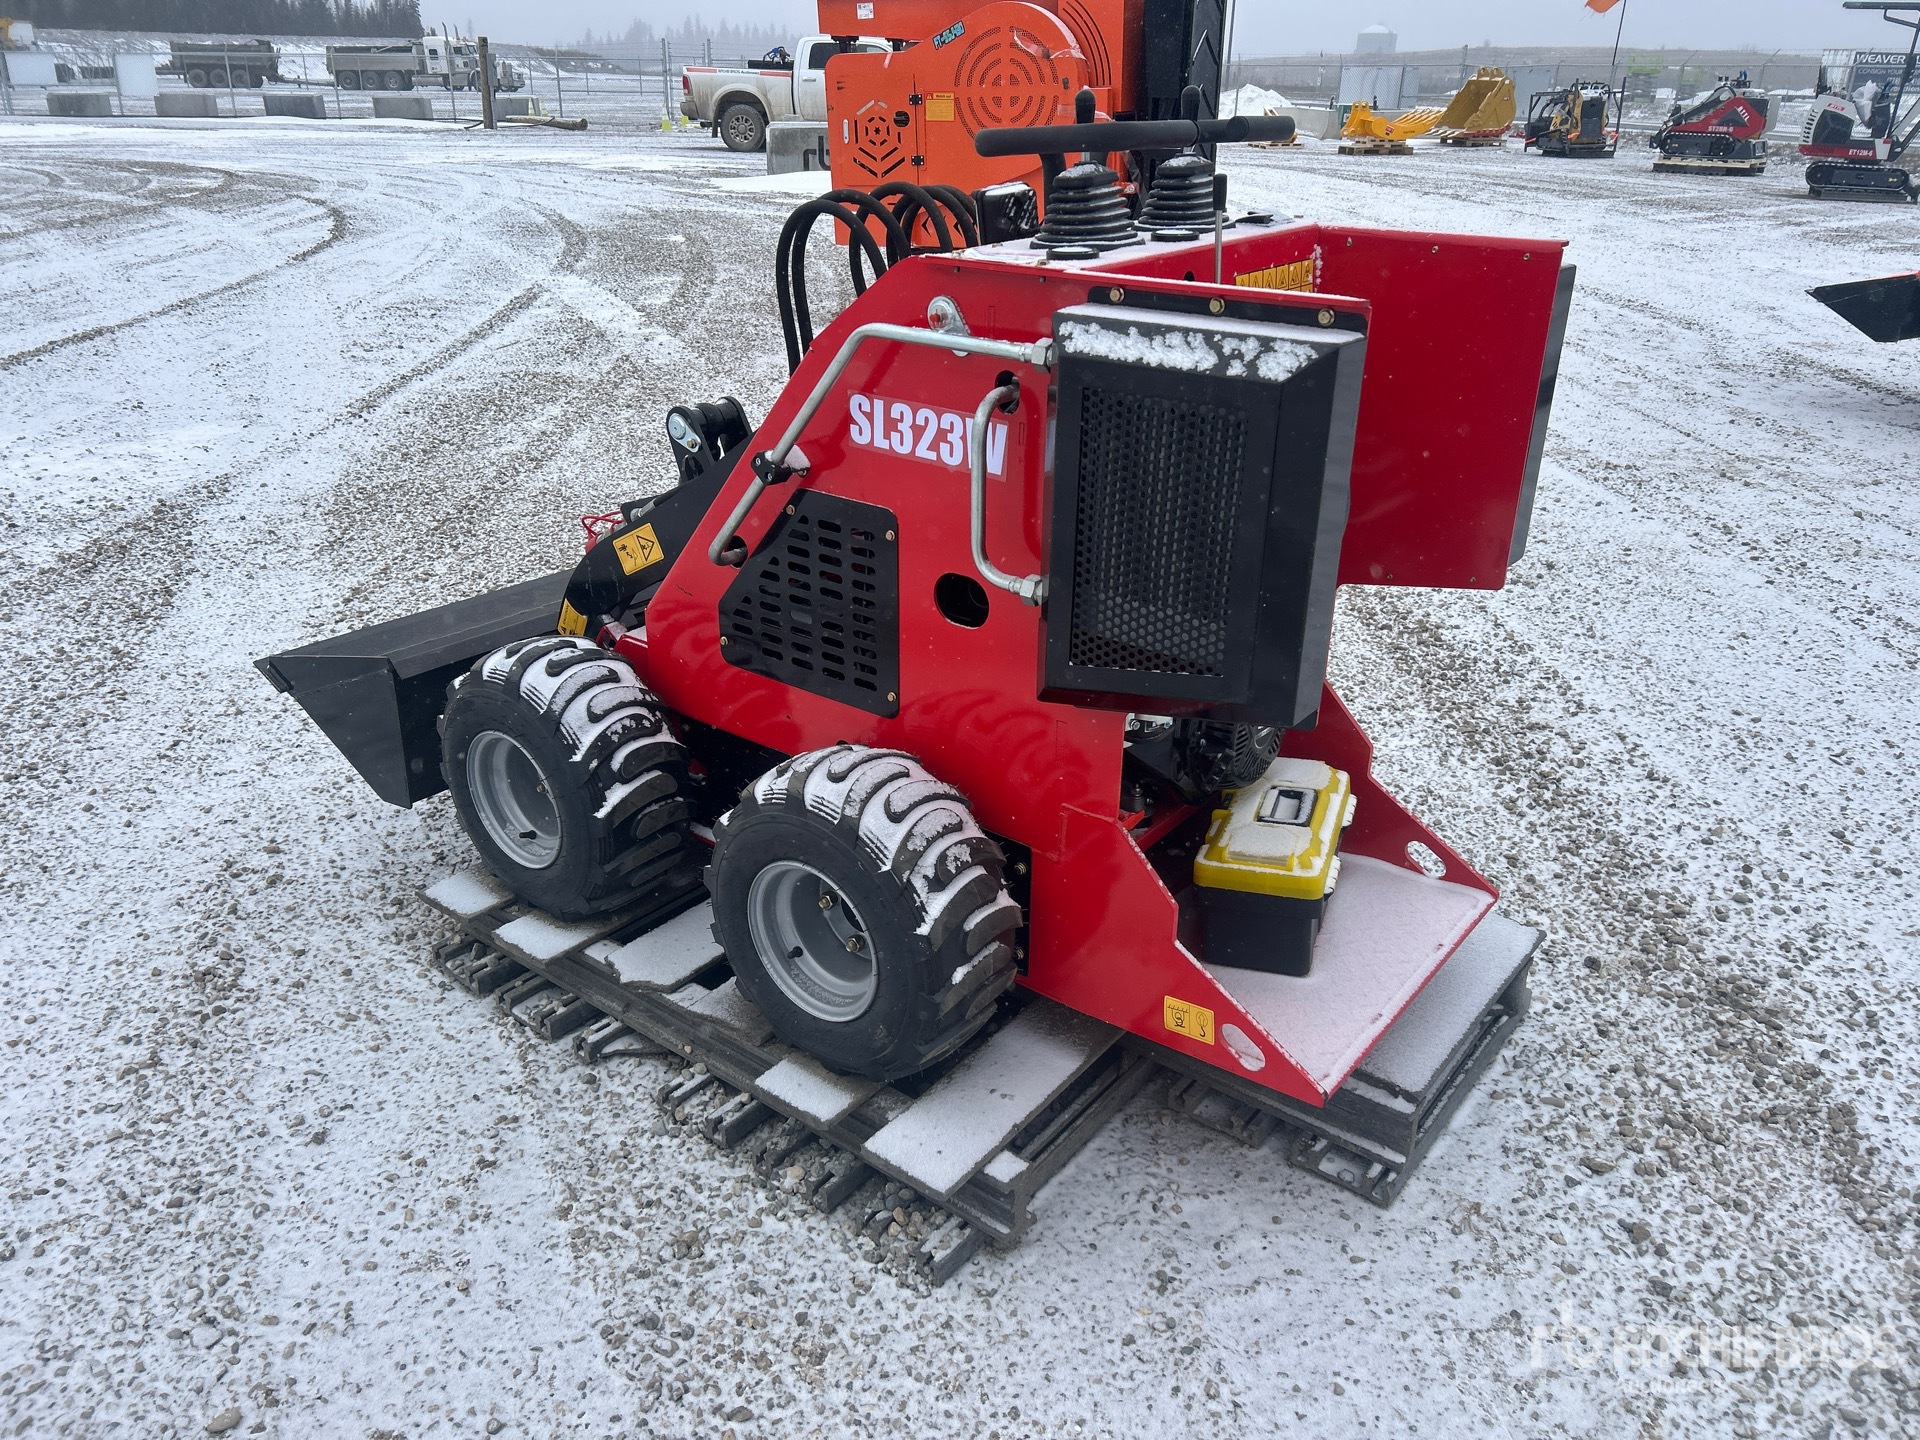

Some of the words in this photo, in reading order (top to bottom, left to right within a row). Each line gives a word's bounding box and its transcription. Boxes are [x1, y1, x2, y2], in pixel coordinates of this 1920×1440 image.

[1856, 54, 1906, 64] WEAVER
[1848, 148, 1874, 157] ET12M-6
[849, 394, 1007, 475] SL323W
